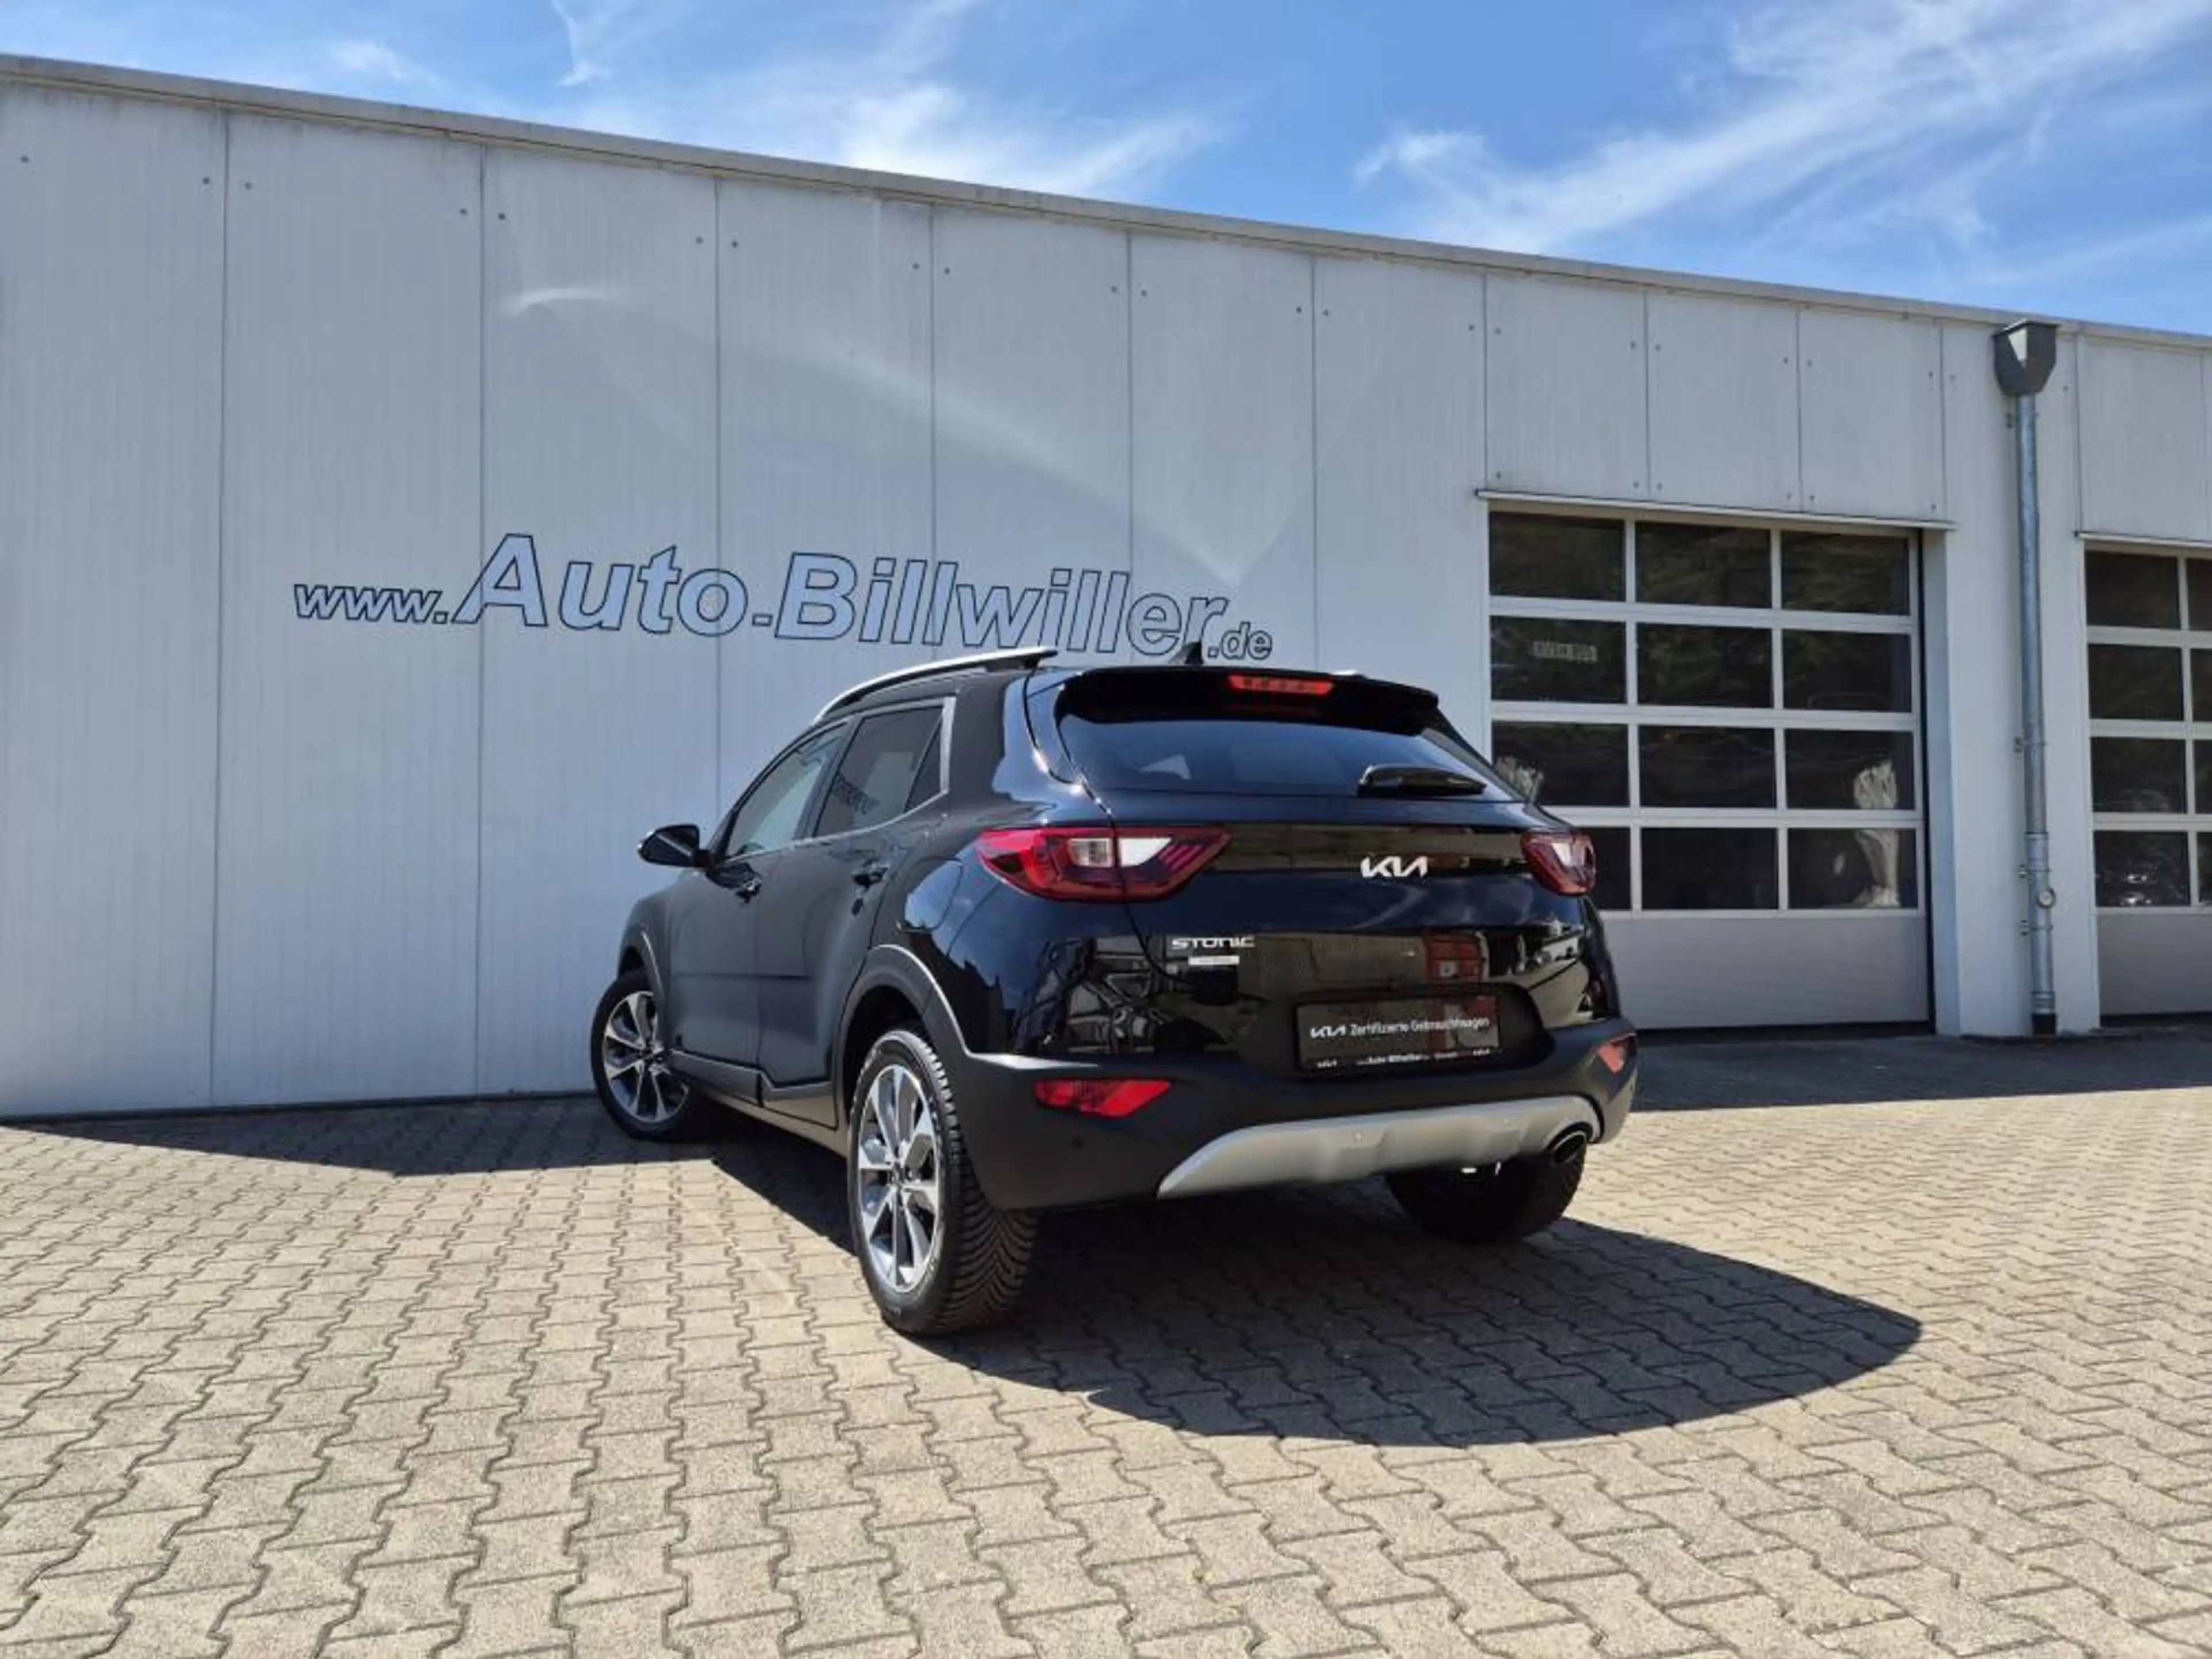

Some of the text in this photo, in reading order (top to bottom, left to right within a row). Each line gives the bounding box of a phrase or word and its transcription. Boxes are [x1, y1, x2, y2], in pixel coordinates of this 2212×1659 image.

[293, 533, 1272, 660] www.Auto-Billwiller.de
[1360, 855, 1429, 878] KIA
[1171, 935, 1256, 950] STONIC
[1310, 1025, 1346, 1039] KIA
